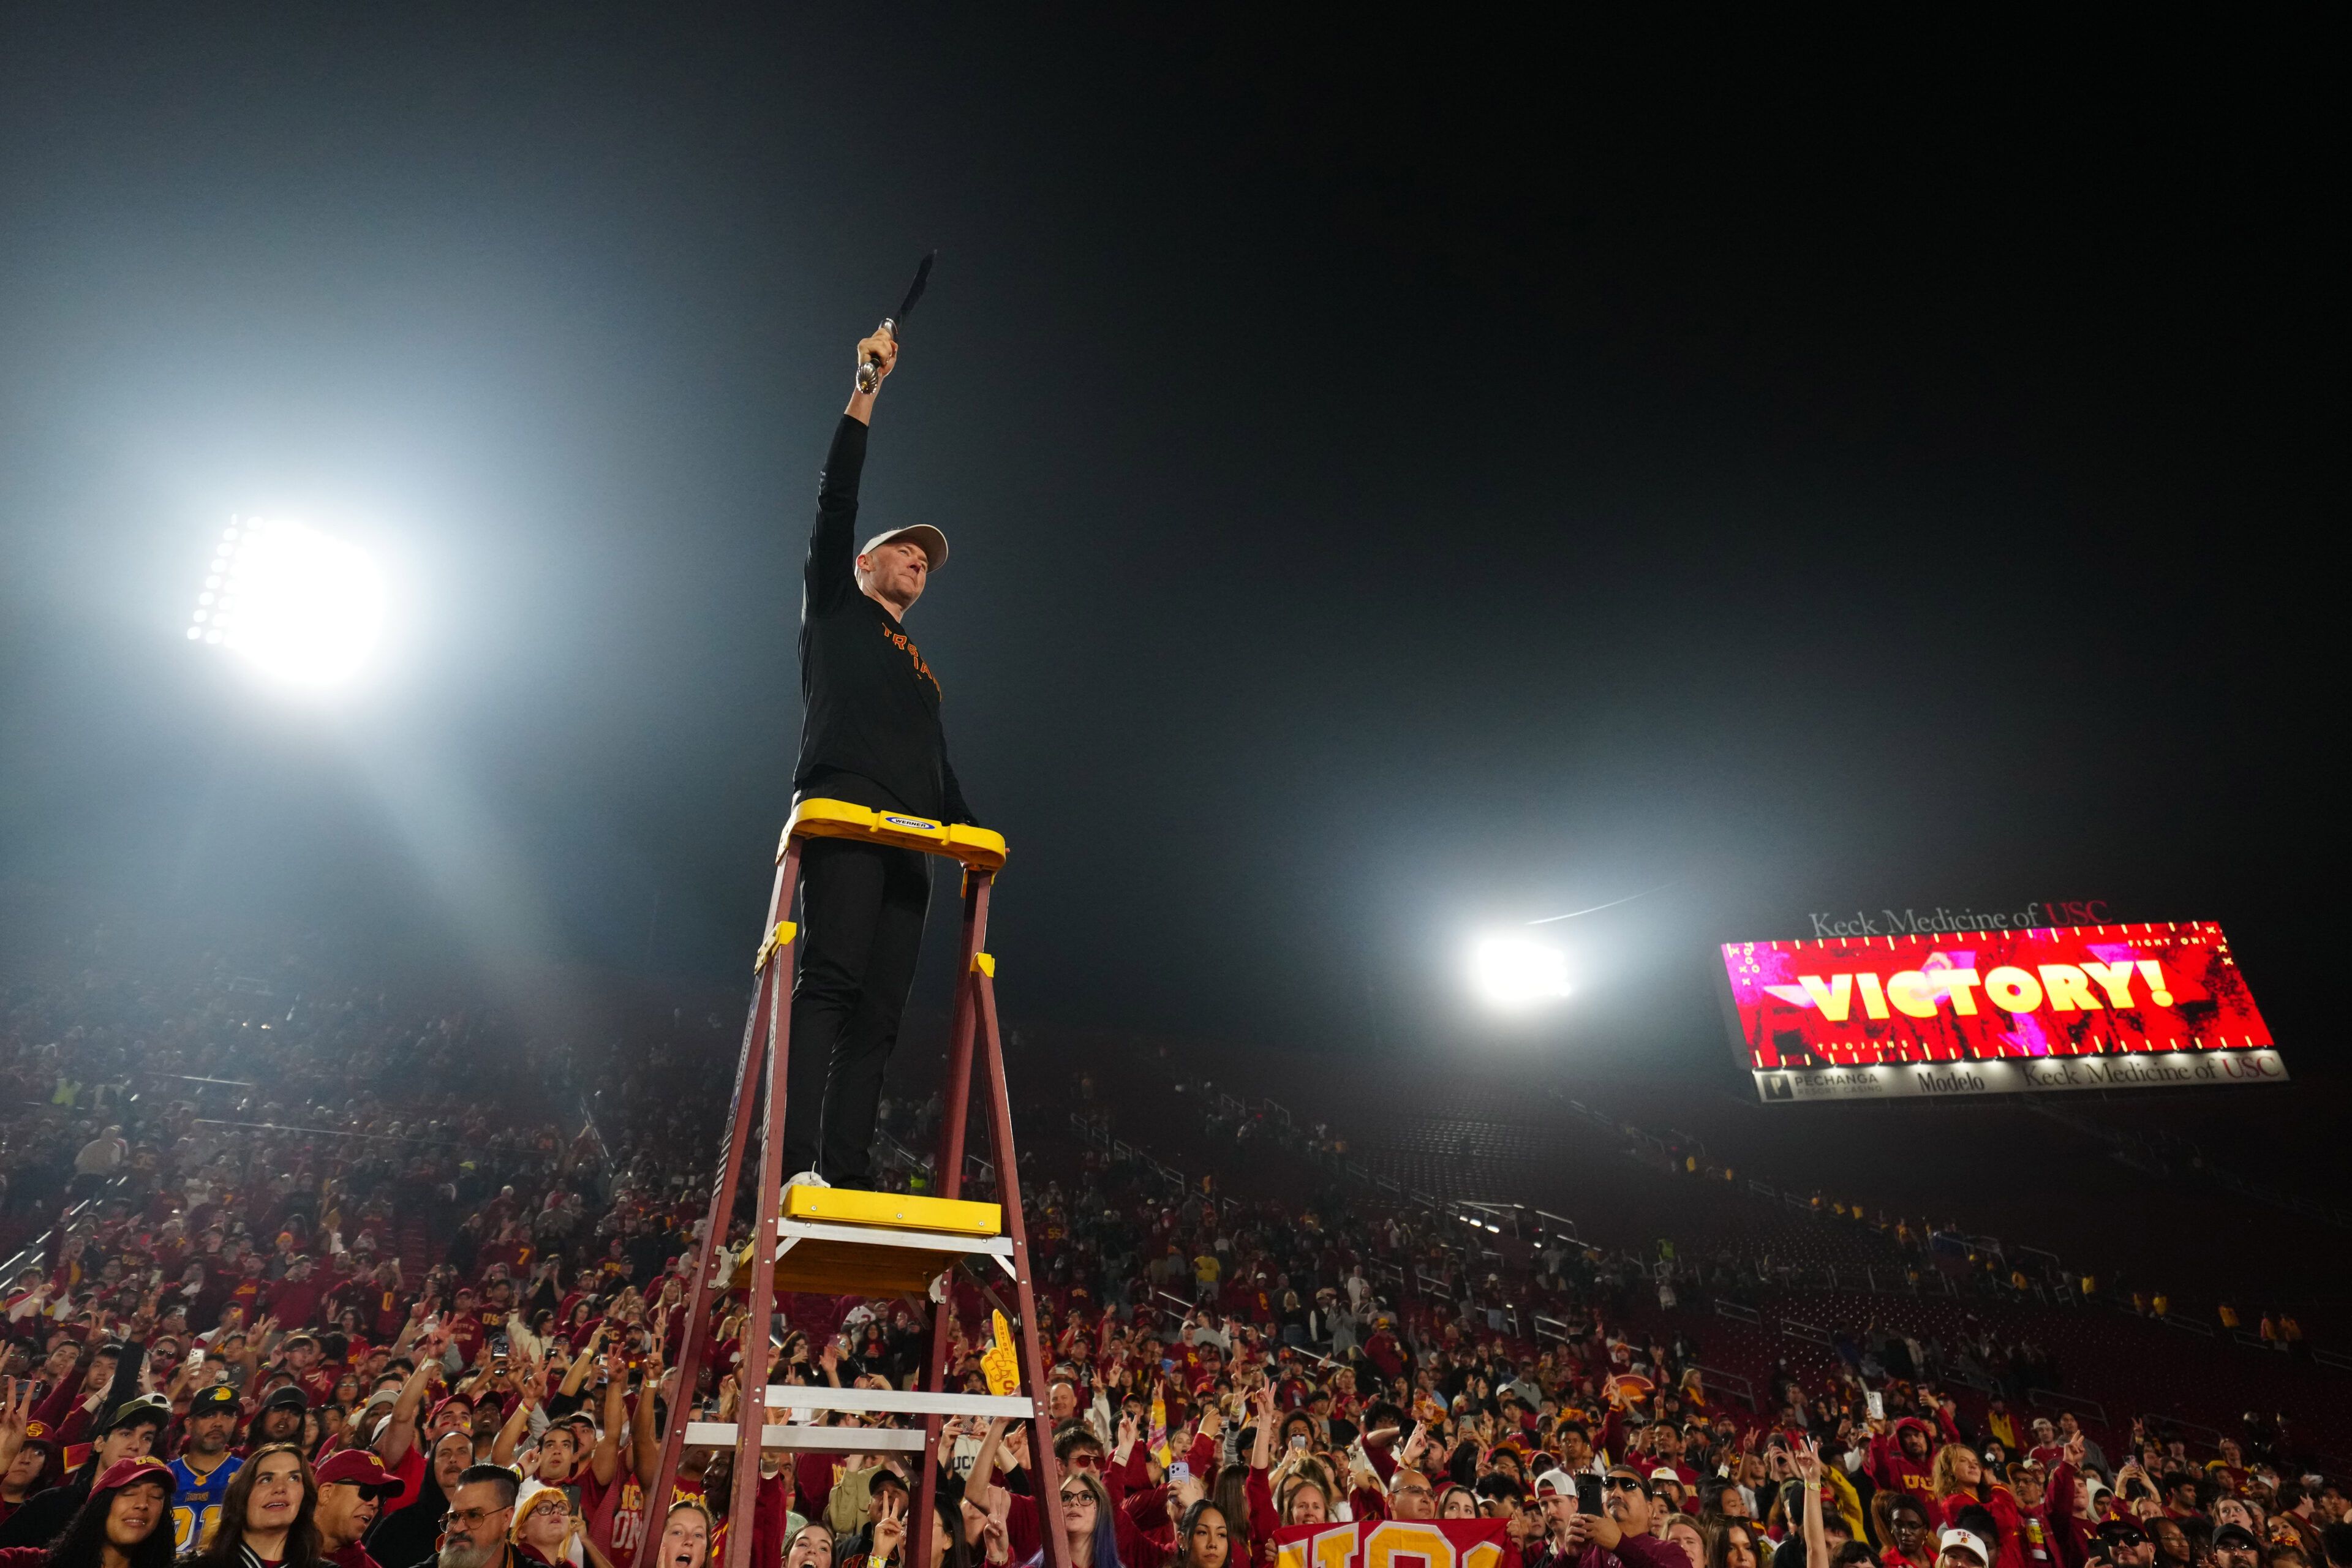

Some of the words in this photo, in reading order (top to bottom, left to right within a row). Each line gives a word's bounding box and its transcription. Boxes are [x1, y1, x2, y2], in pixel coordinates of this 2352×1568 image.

[895, 819, 925, 827] WERNER
[1809, 911, 1880, 937] Keck
[1882, 908, 2008, 933] Medicine
[2013, 902, 2041, 927] of
[2045, 900, 2113, 926] USC
[1798, 960, 2174, 1022] VICTORY!
[1817, 1040, 1908, 1051] TROJANS
[1795, 1074, 1879, 1087] PECHANGA
[2022, 1065, 2081, 1087] Keck
[2085, 1061, 2191, 1084] Medicine
[2195, 1058, 2216, 1079] of
[2221, 1057, 2280, 1079] USC
[1917, 1072, 1985, 1093] Modelo
[517, 1248, 530, 1265] 7
